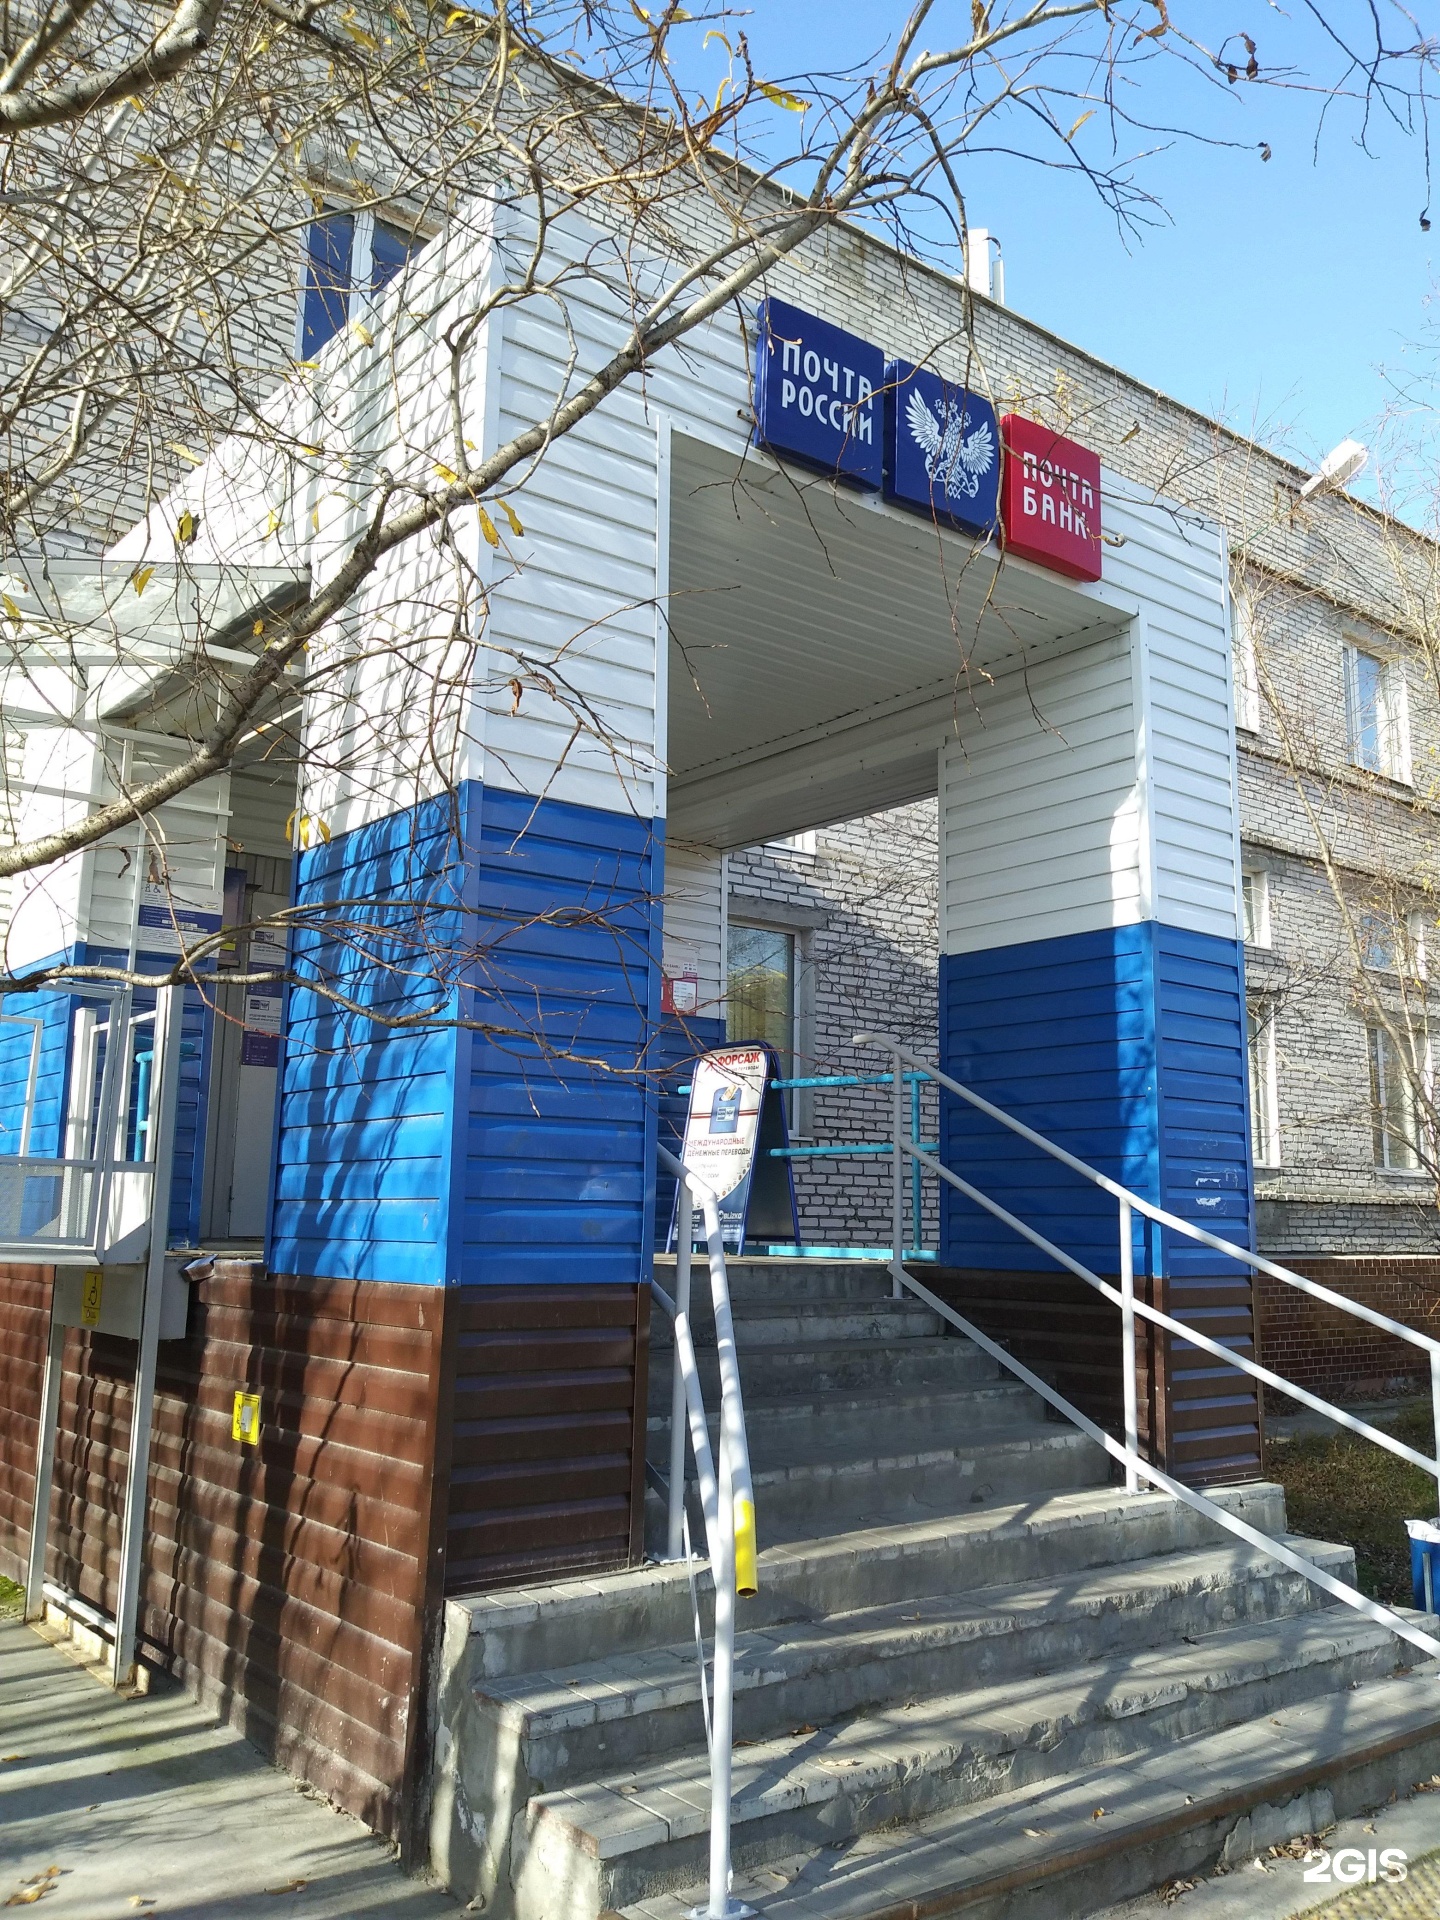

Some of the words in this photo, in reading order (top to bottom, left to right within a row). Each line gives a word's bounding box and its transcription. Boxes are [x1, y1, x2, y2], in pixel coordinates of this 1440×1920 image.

[782, 341, 873, 411] ПОЧТА
[781, 379, 873, 445] РОССИИ
[1022, 451, 1094, 509] ПОЧТА
[1022, 488, 1088, 540] БАНК
[717, 1052, 761, 1066] ФОРСАЖ
[688, 1138, 746, 1147] МЕЖДУНАРОДНЫЕ
[721, 1148, 751, 1156] ПЕРЕВОДЫ
